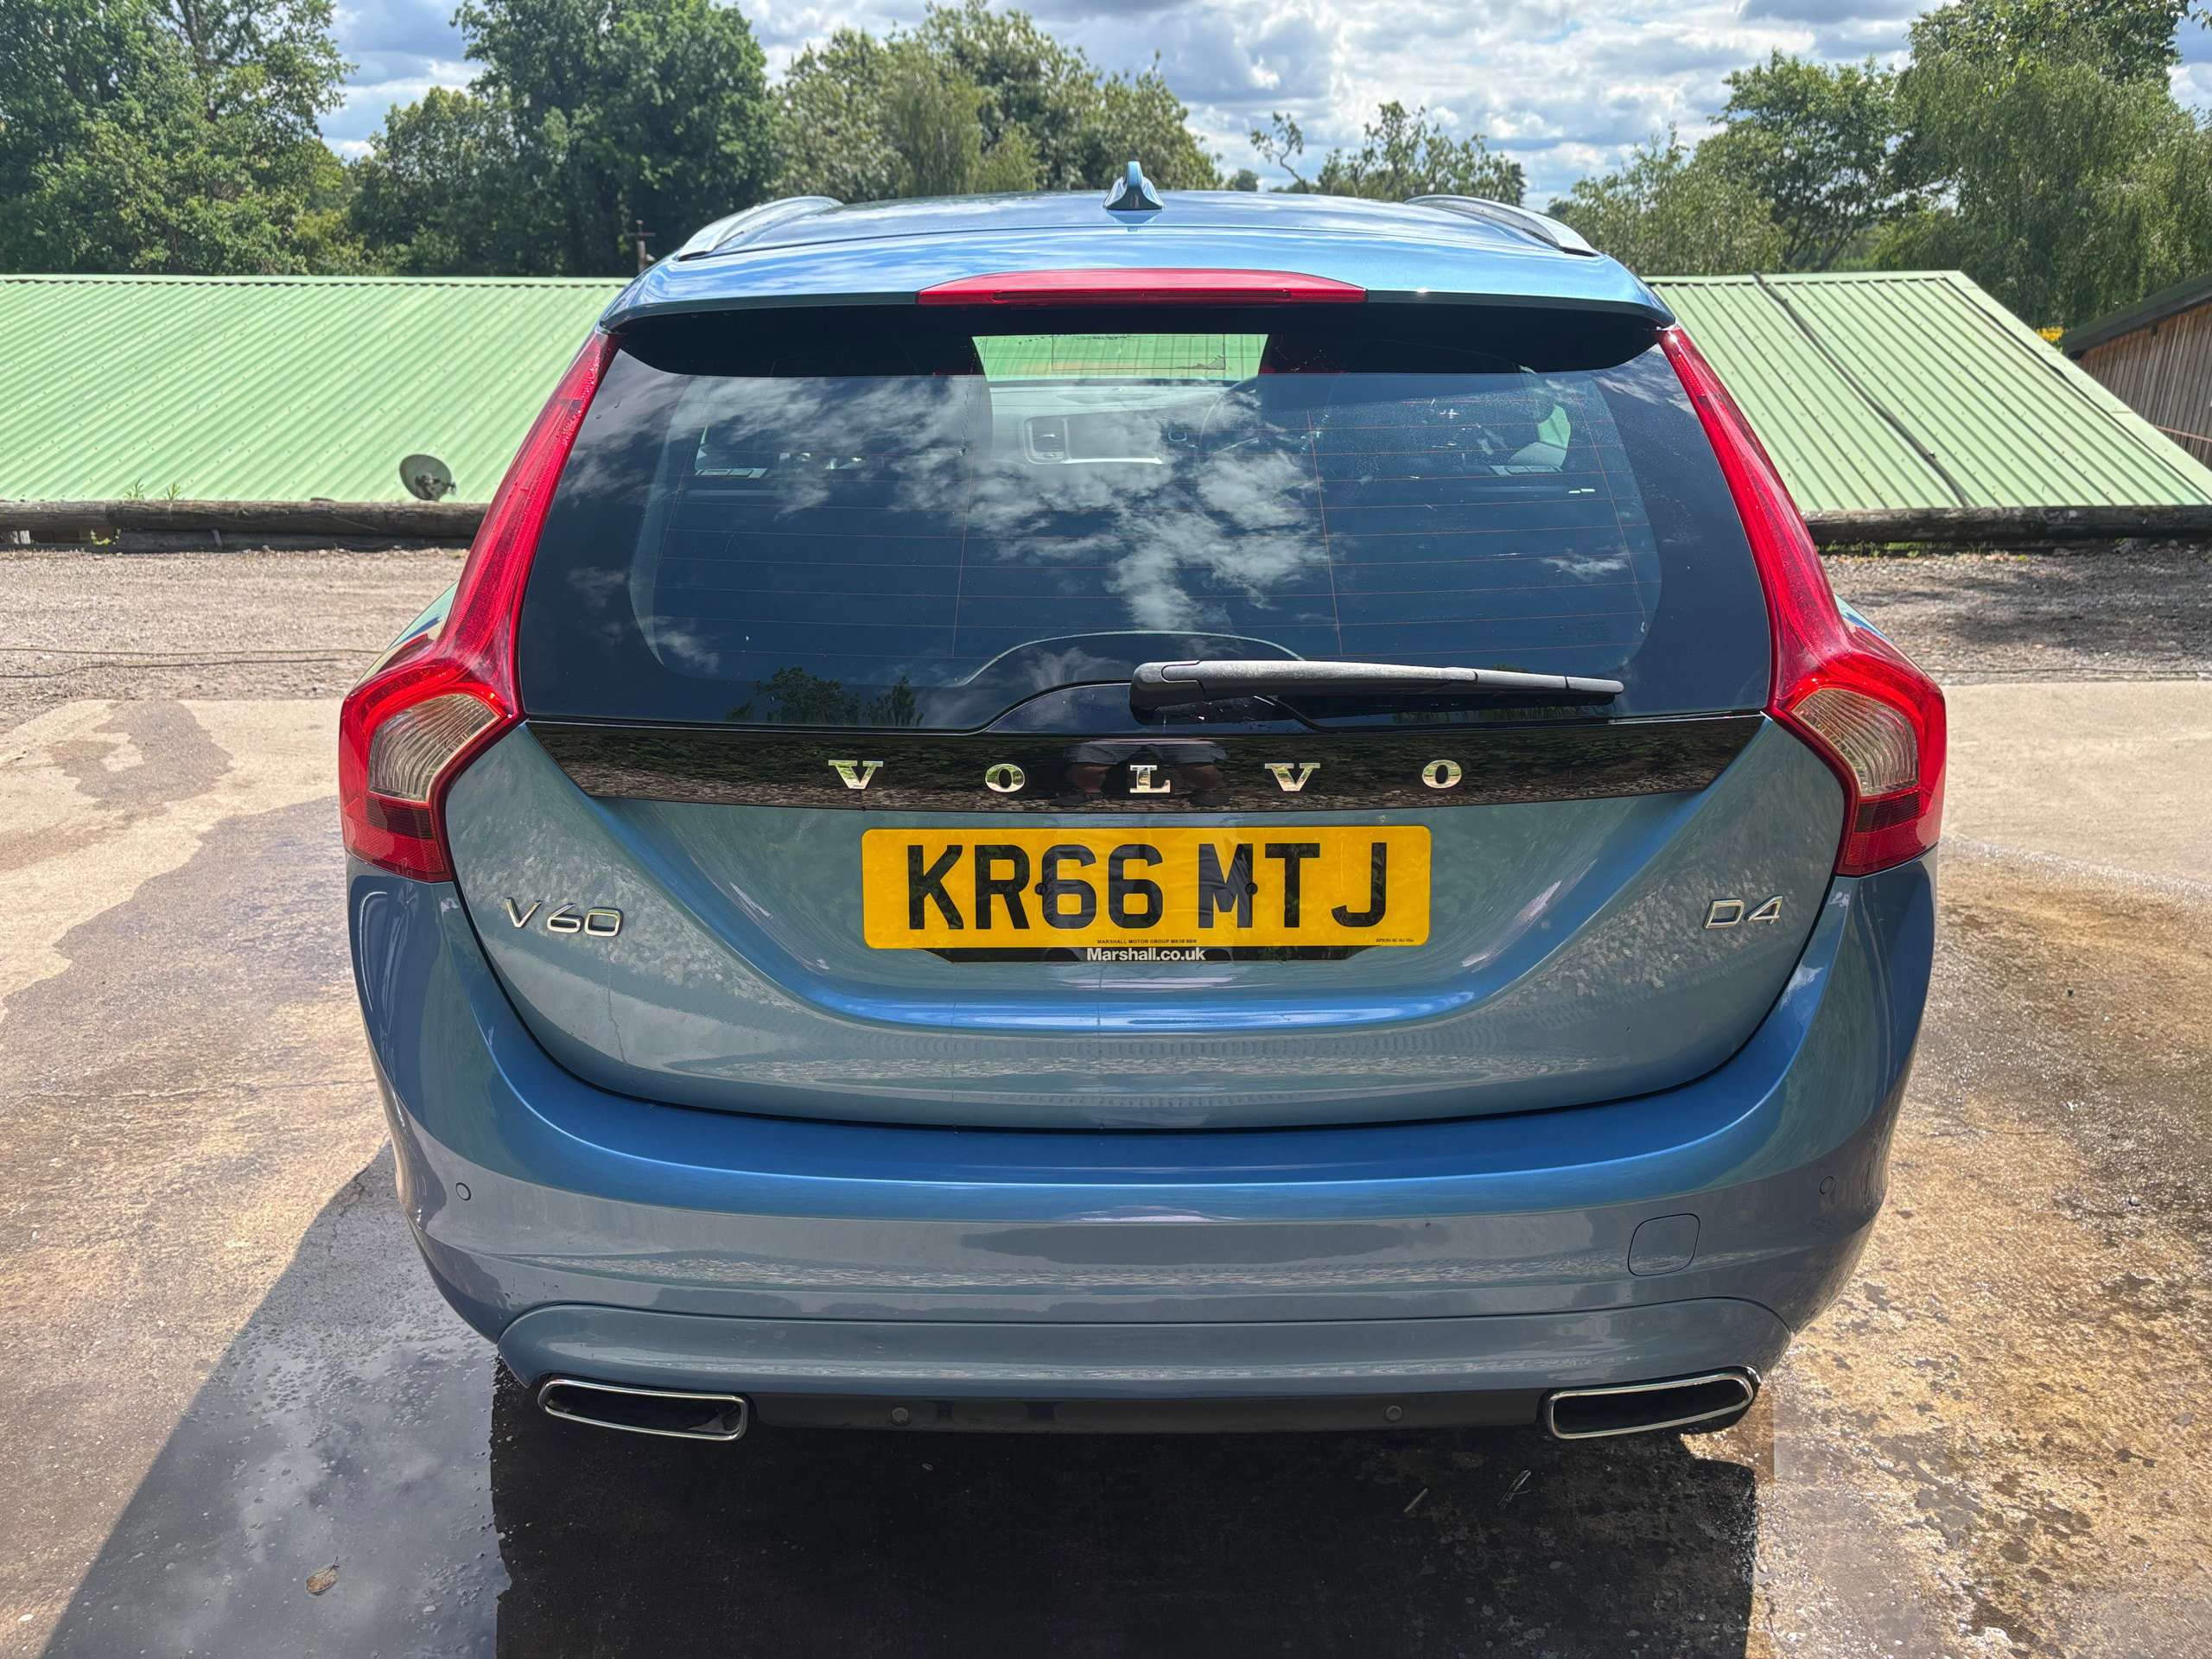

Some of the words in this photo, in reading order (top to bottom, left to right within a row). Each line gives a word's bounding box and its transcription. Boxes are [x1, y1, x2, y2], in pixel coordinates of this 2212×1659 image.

[828, 760, 1462, 794] VOLVO
[907, 843, 1164, 930] KR66
[1198, 842, 1388, 929] MTJ
[505, 897, 624, 937] V60
[1703, 895, 1783, 929] D4
[1087, 947, 1206, 961] Marshall.co.uk
